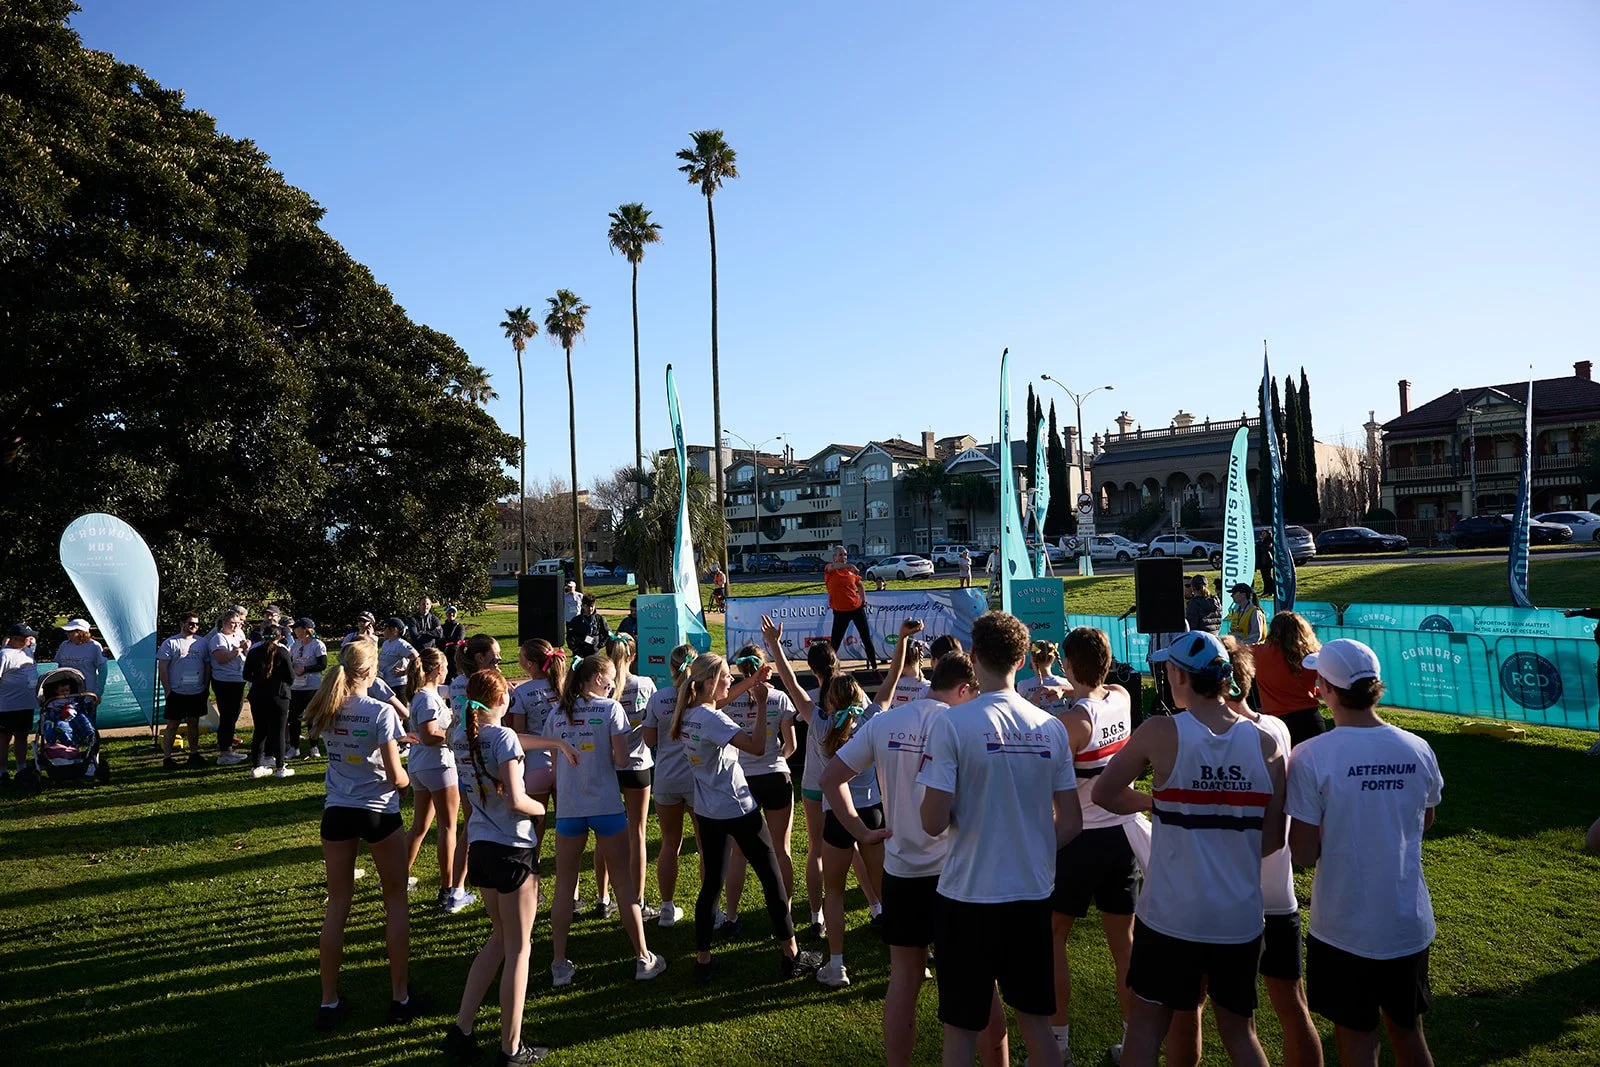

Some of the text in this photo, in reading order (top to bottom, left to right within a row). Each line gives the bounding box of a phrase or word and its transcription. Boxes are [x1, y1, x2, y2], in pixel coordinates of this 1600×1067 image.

[1225, 455, 1239, 589] CONNOR'S RUN
[1017, 586, 1058, 599] CONNOR'S
[877, 601, 930, 615] presented
[931, 602, 945, 613] by
[1358, 613, 1401, 626] CONNOR'S
[1402, 647, 1461, 664] CONNOR'S
[1420, 662, 1443, 672] RUN
[1512, 672, 1549, 688] RCD
[983, 732, 1051, 744] TONNERS
[1347, 763, 1416, 777] AETERNUM
[1192, 780, 1222, 790] BOAT
[1361, 779, 1404, 791] FORTIS
